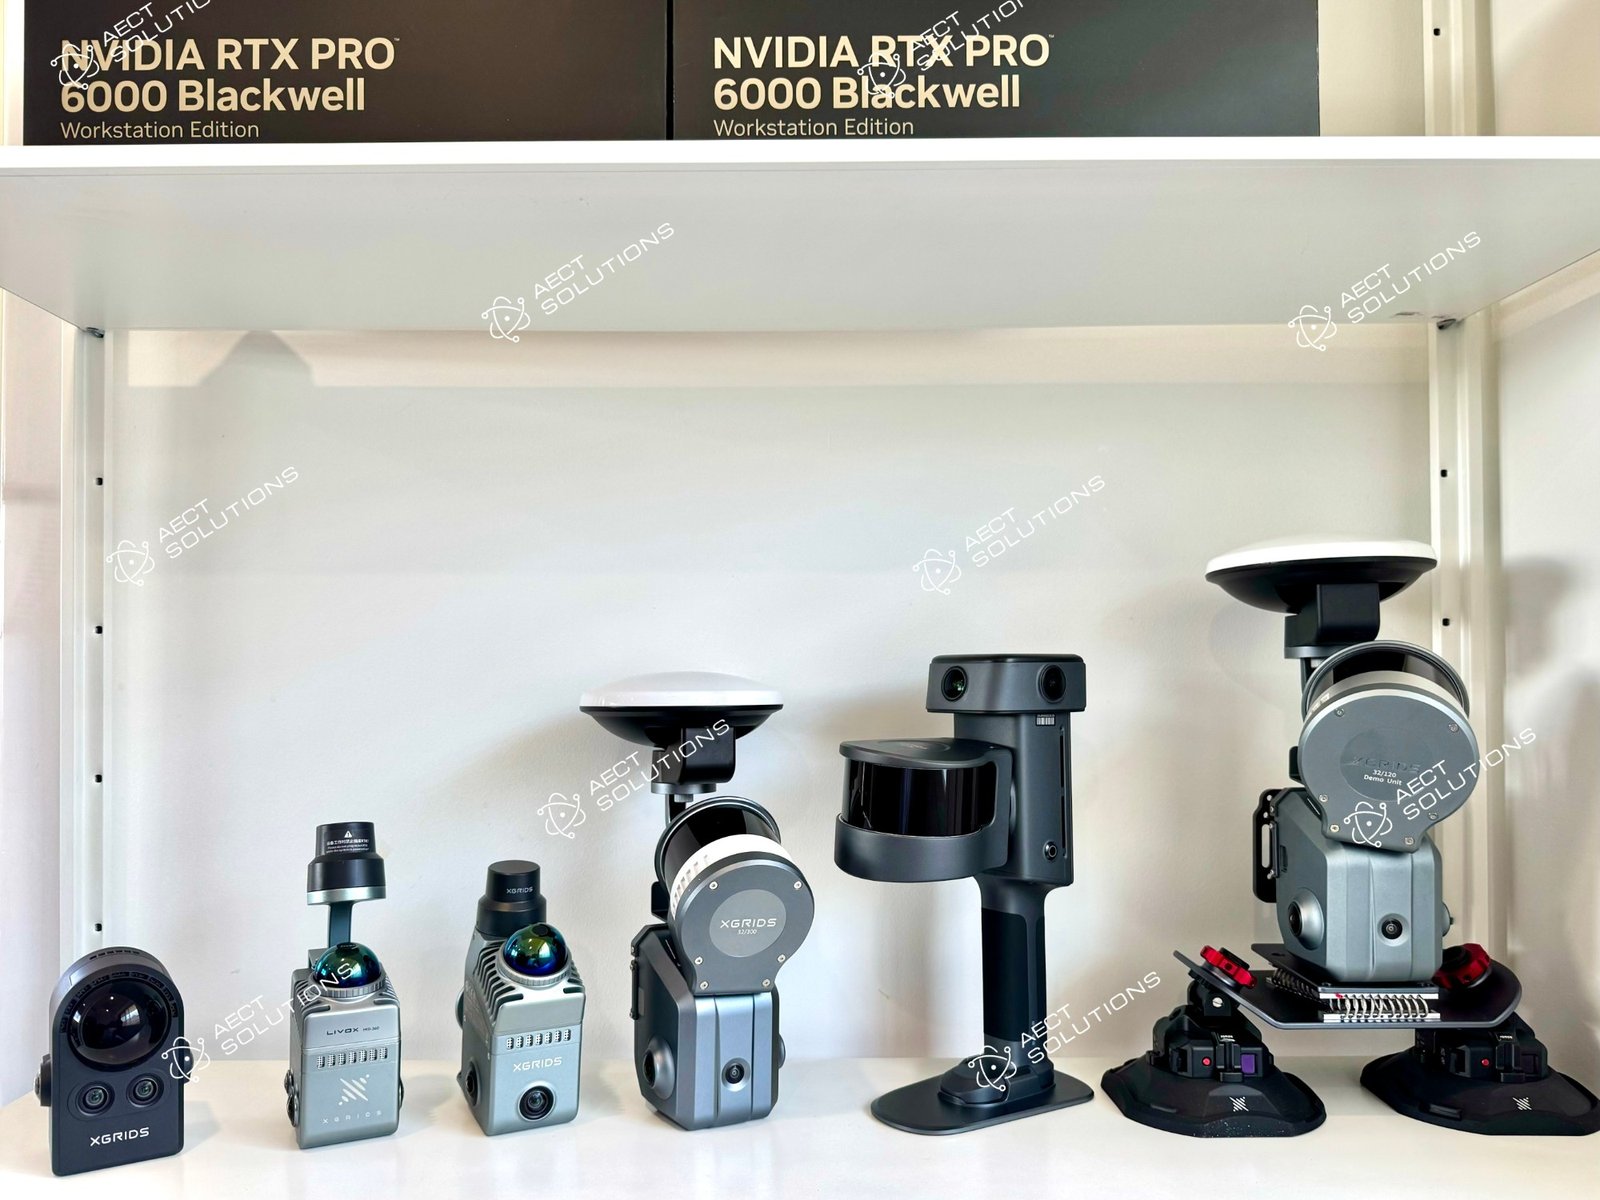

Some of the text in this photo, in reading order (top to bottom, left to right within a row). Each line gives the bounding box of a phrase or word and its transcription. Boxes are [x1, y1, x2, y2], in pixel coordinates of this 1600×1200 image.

[61, 38, 206, 71] NVIDIA
[217, 38, 299, 70] RTX
[714, 35, 860, 69] NVIDIA
[871, 35, 954, 68] RTX
[61, 77, 365, 113] 6000 Blackwell
[714, 74, 1020, 110] 6000 Blackwell
[60, 120, 259, 139] Workstation Edition
[713, 117, 914, 137] Workstation Edition
[1363, 774, 1402, 786] Demo Unit
[1372, 769, 1397, 778] 32/120
[720, 918, 777, 928] XGRIDS
[512, 1057, 563, 1072] XGRIDS
[90, 1127, 150, 1147] XGRIDS
